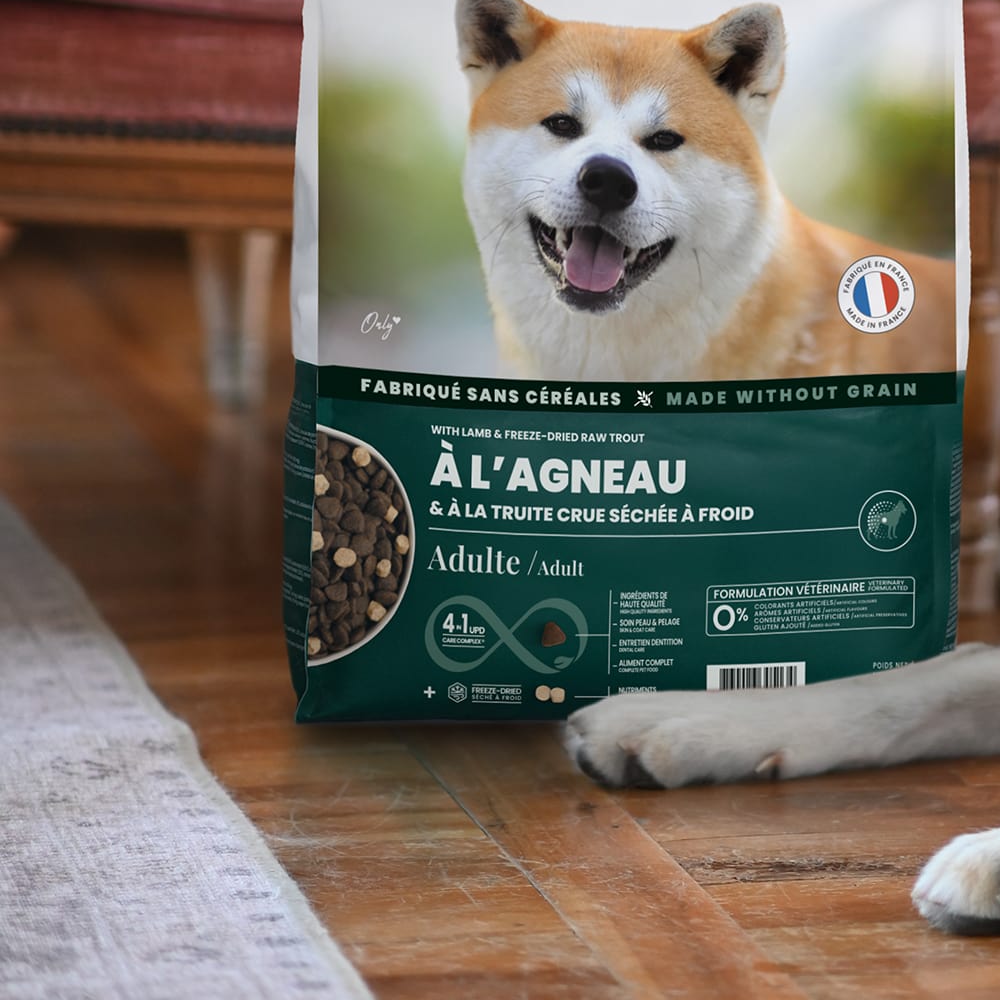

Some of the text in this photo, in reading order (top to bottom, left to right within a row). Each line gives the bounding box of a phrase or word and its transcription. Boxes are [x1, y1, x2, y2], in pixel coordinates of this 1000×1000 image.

[843, 261, 872, 294] FABRIQUÉ
[887, 264, 909, 292] FRANCE
[846, 308, 865, 326] MADE
[878, 306, 906, 328] FRANCE
[360, 378, 917, 406] FABRIQUÉ SANS CÉRÉALES MADE WITHOUT GRAIN
[431, 425, 645, 443] WITH LAMB & FREEZE-DRIED RAW TROUT
[430, 440, 686, 494] À L'AGNEAU
[429, 498, 754, 522] & À LA TRUITE CRUE SÉCHÉE À FROID
[427, 545, 520, 575] Adulte
[714, 582, 865, 599] FORMULATION VÉTÉRINAIRE
[641, 599, 665, 608] QUALITÉ
[658, 618, 680, 626] PELAGE
[713, 605, 748, 631] 0%
[754, 615, 810, 623] CONSERVATEURS
[651, 638, 683, 646] DENTITION
